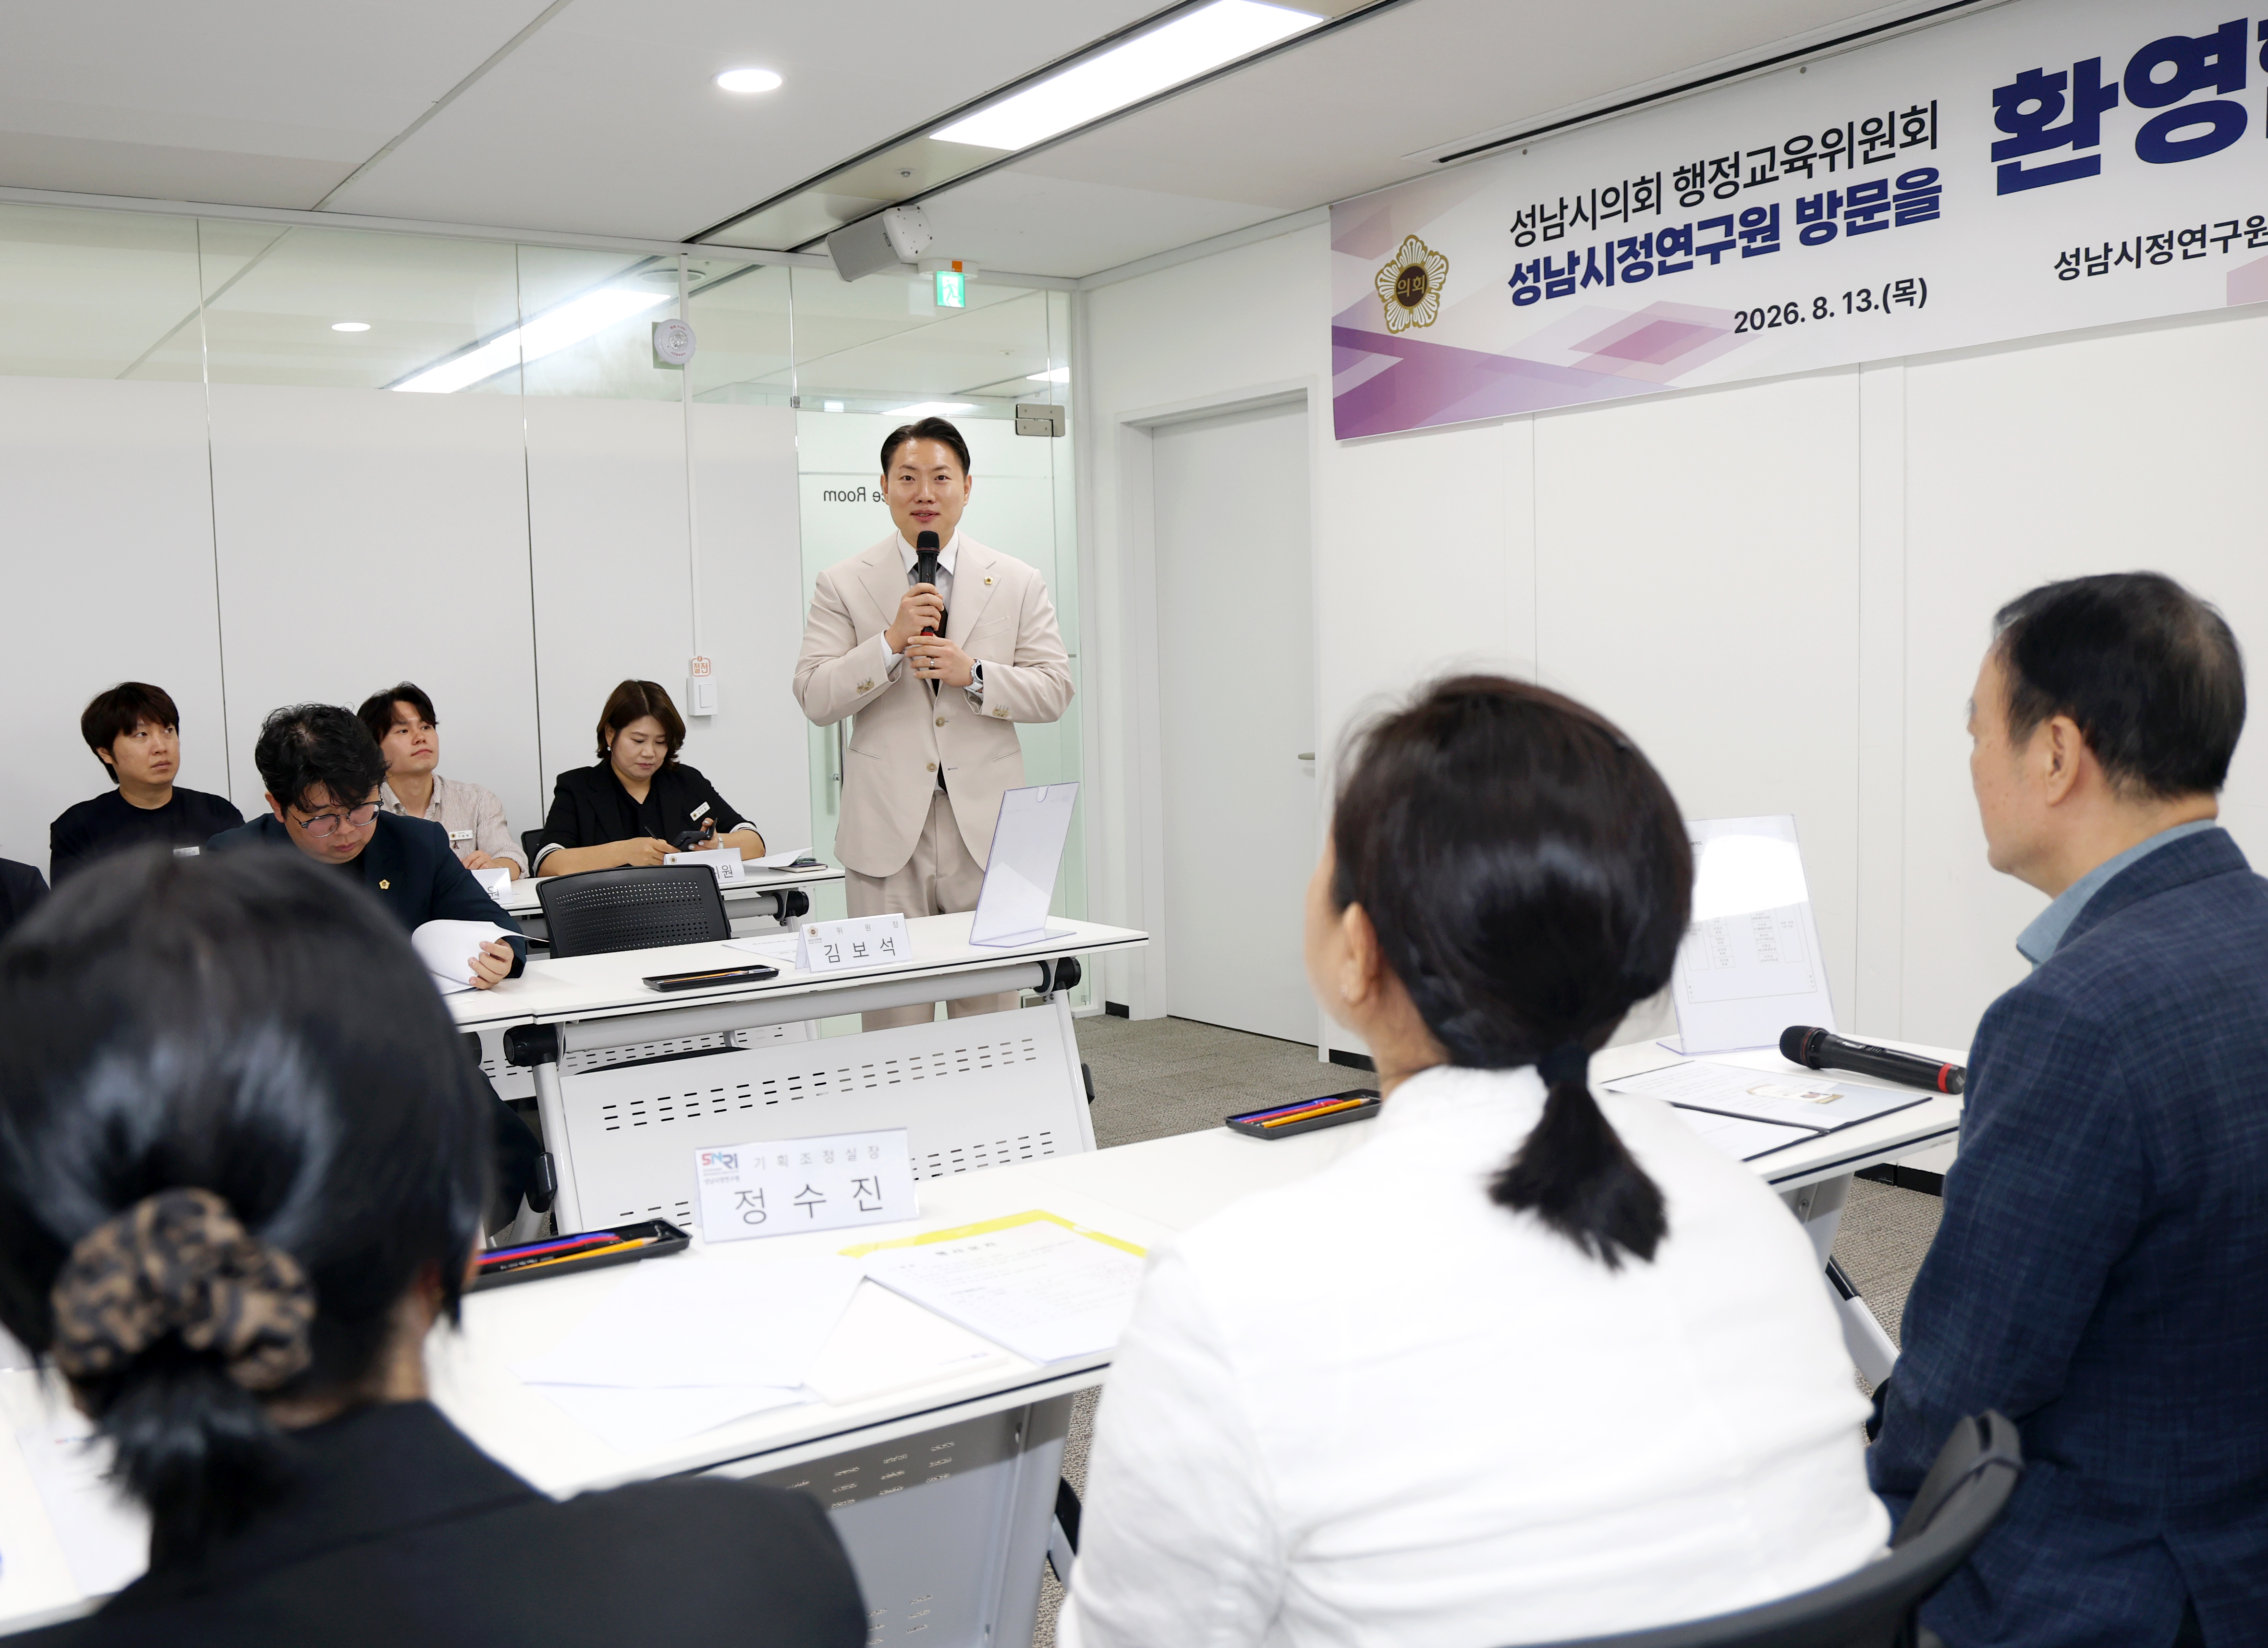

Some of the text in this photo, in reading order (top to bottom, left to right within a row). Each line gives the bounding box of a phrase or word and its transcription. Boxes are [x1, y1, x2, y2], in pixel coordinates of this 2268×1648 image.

[1991, 17, 2268, 196] 환영
[1510, 100, 1937, 247] 성남시의회 행정교육위원회
[1508, 168, 1942, 306] 성남시정연구원 방문을
[2054, 216, 2268, 280] 성남시정연구원
[1398, 275, 1425, 297] 의회
[1735, 278, 1927, 333] 2026. 8. 13.(목)
[694, 663, 708, 674] 절전
[714, 864, 733, 879] 원
[824, 937, 896, 963] 김보석
[734, 1175, 883, 1225] 정수진
